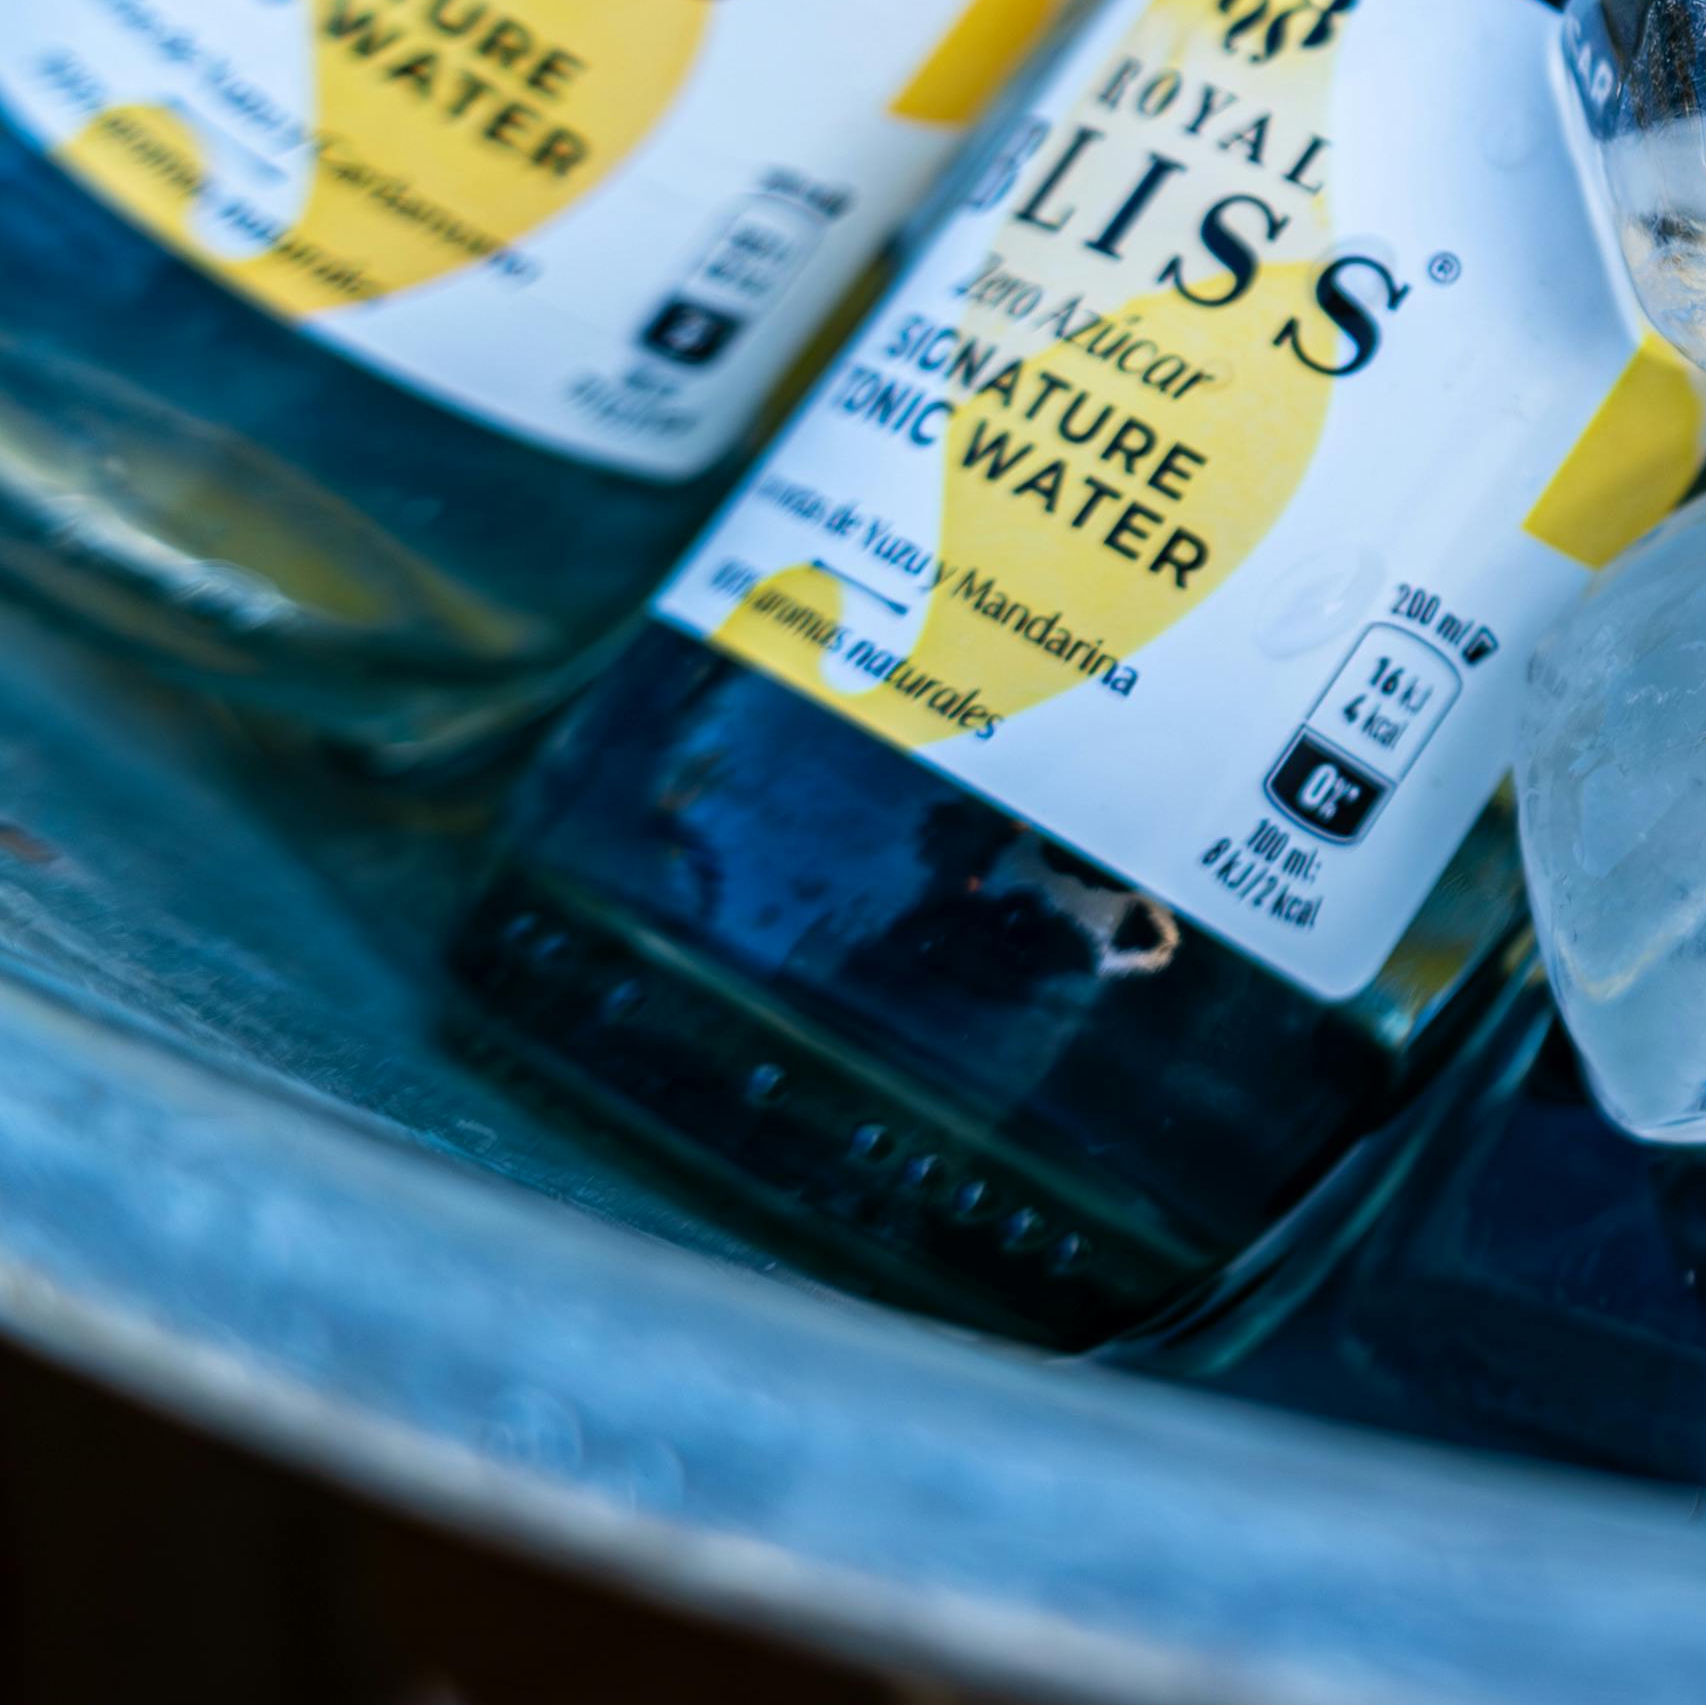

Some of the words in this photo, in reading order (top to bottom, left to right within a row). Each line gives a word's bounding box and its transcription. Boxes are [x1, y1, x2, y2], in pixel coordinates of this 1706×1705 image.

[1096, 56, 1335, 196] ROYAL
[966, 114, 1412, 378] BLISS
[954, 252, 1043, 323] Zero
[1038, 294, 1217, 402] Azúcar
[834, 361, 957, 449] TONIC
[959, 418, 1213, 594] WATER
[886, 313, 1208, 503] SIGNATURE
[862, 515, 935, 578] Yuzu
[952, 564, 1141, 698] Mandarina
[1390, 582, 1442, 627] 200
[845, 637, 1005, 741] naturales
[1369, 655, 1407, 696] 16
[1200, 835, 1233, 869] 8
[1268, 883, 1326, 930] kcal
[1246, 817, 1291, 863] 100
